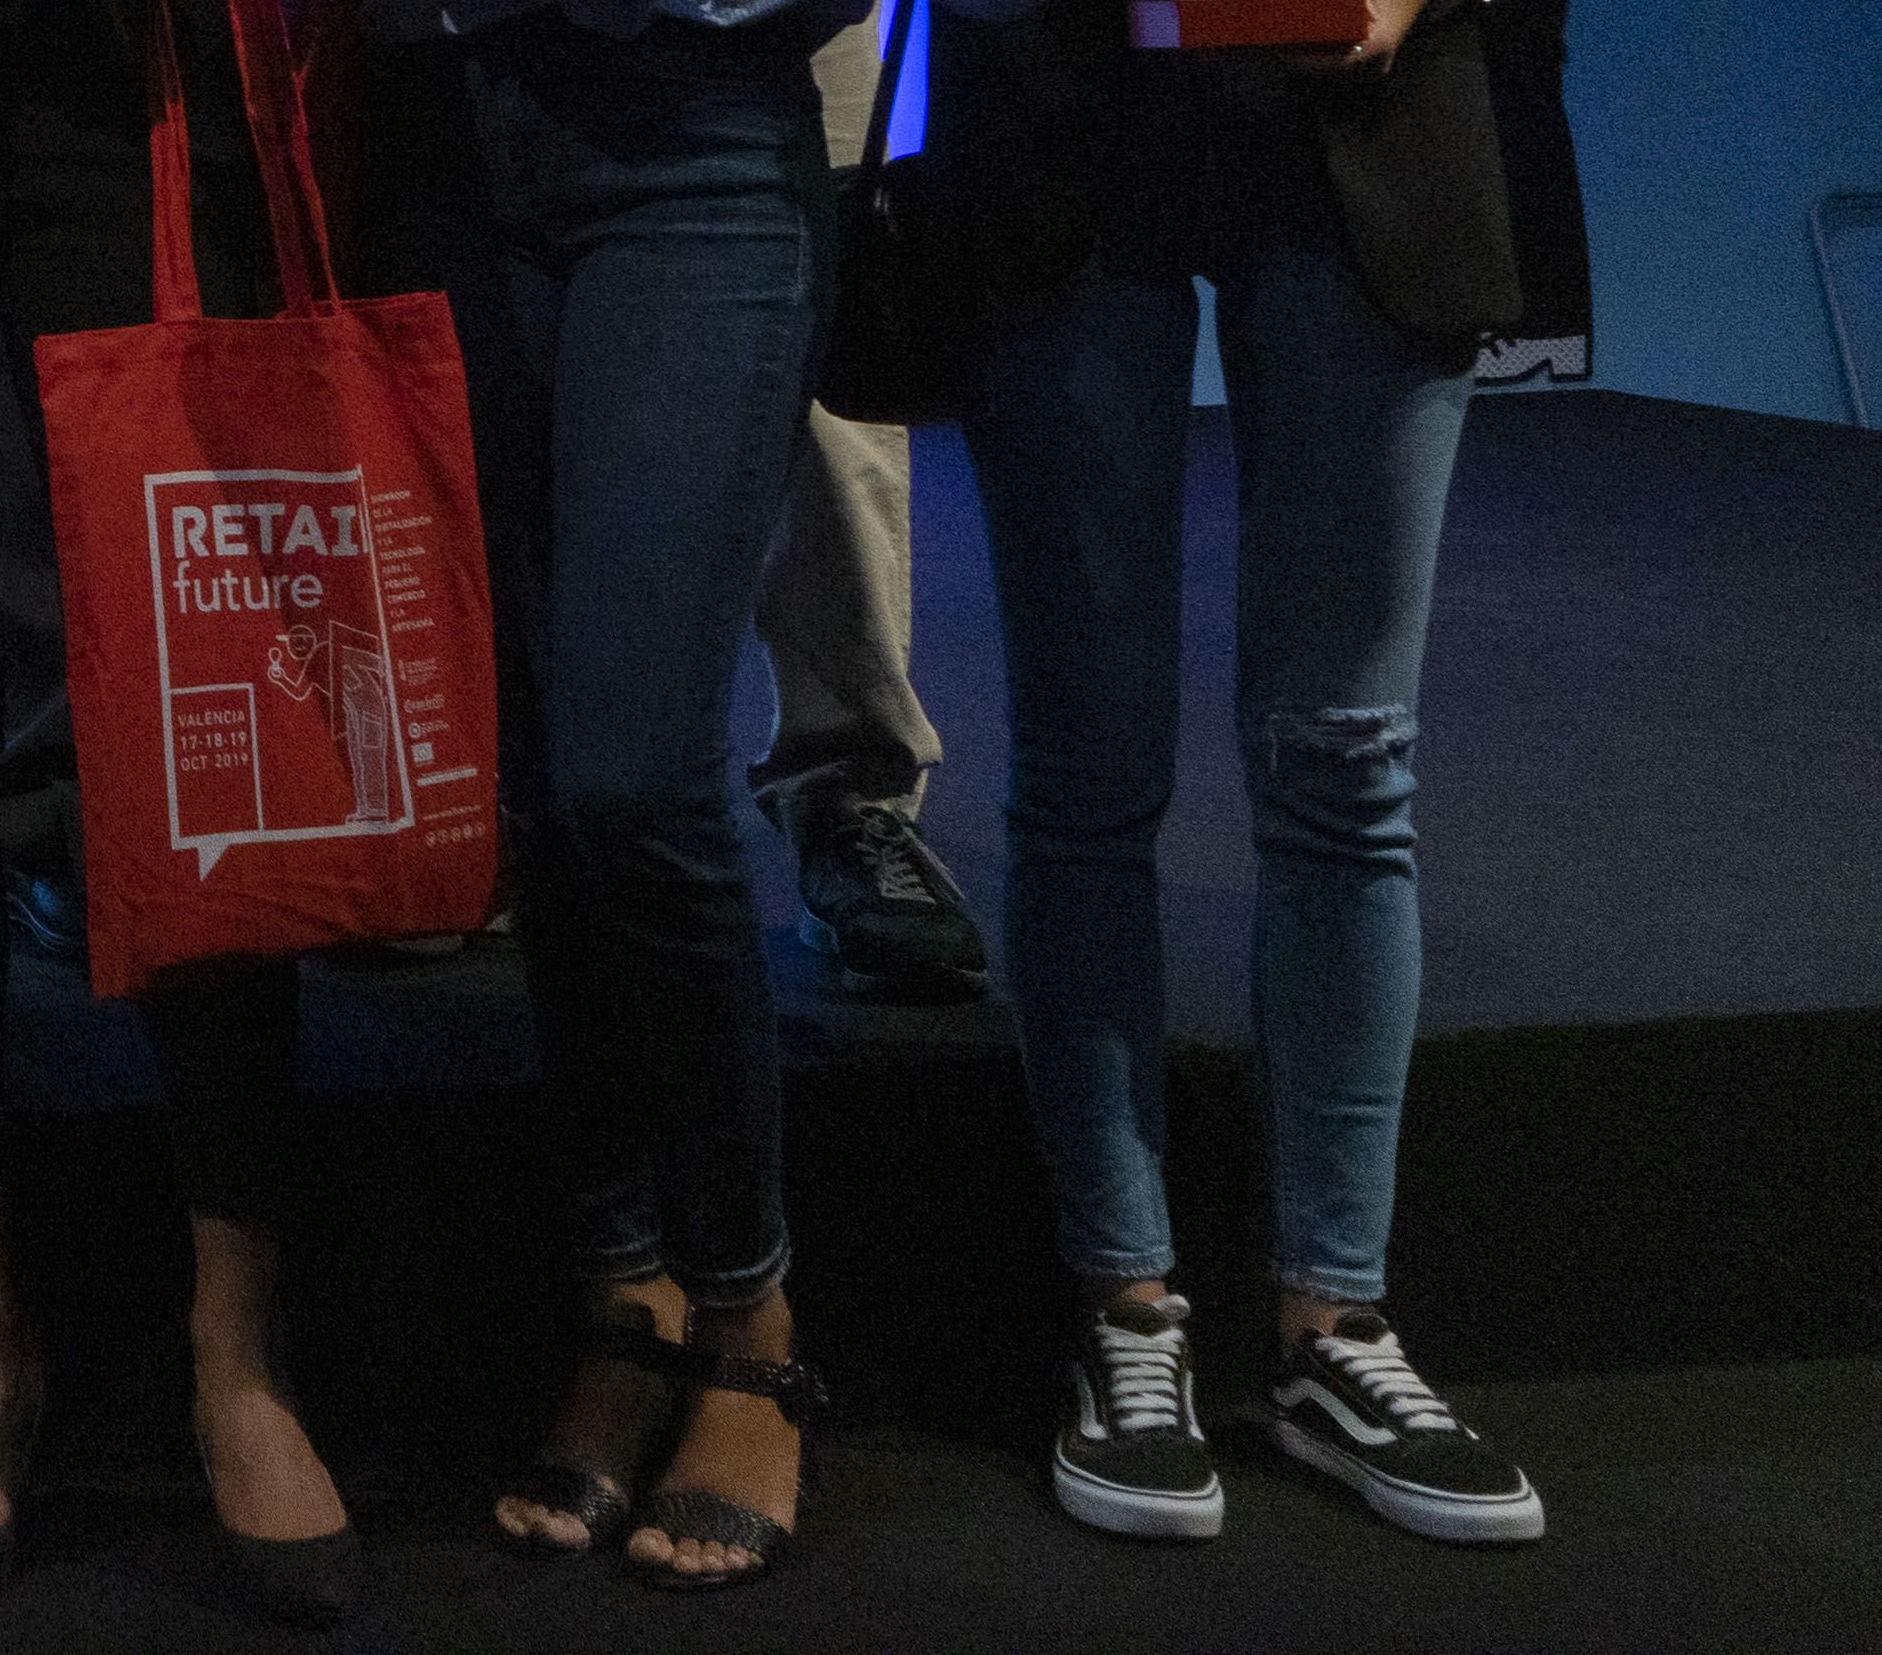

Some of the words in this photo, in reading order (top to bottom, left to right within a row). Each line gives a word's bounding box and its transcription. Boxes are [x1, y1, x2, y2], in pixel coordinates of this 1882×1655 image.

[172, 560, 325, 614] future
[180, 754, 208, 772] OCT
[215, 751, 249, 769] 2019
